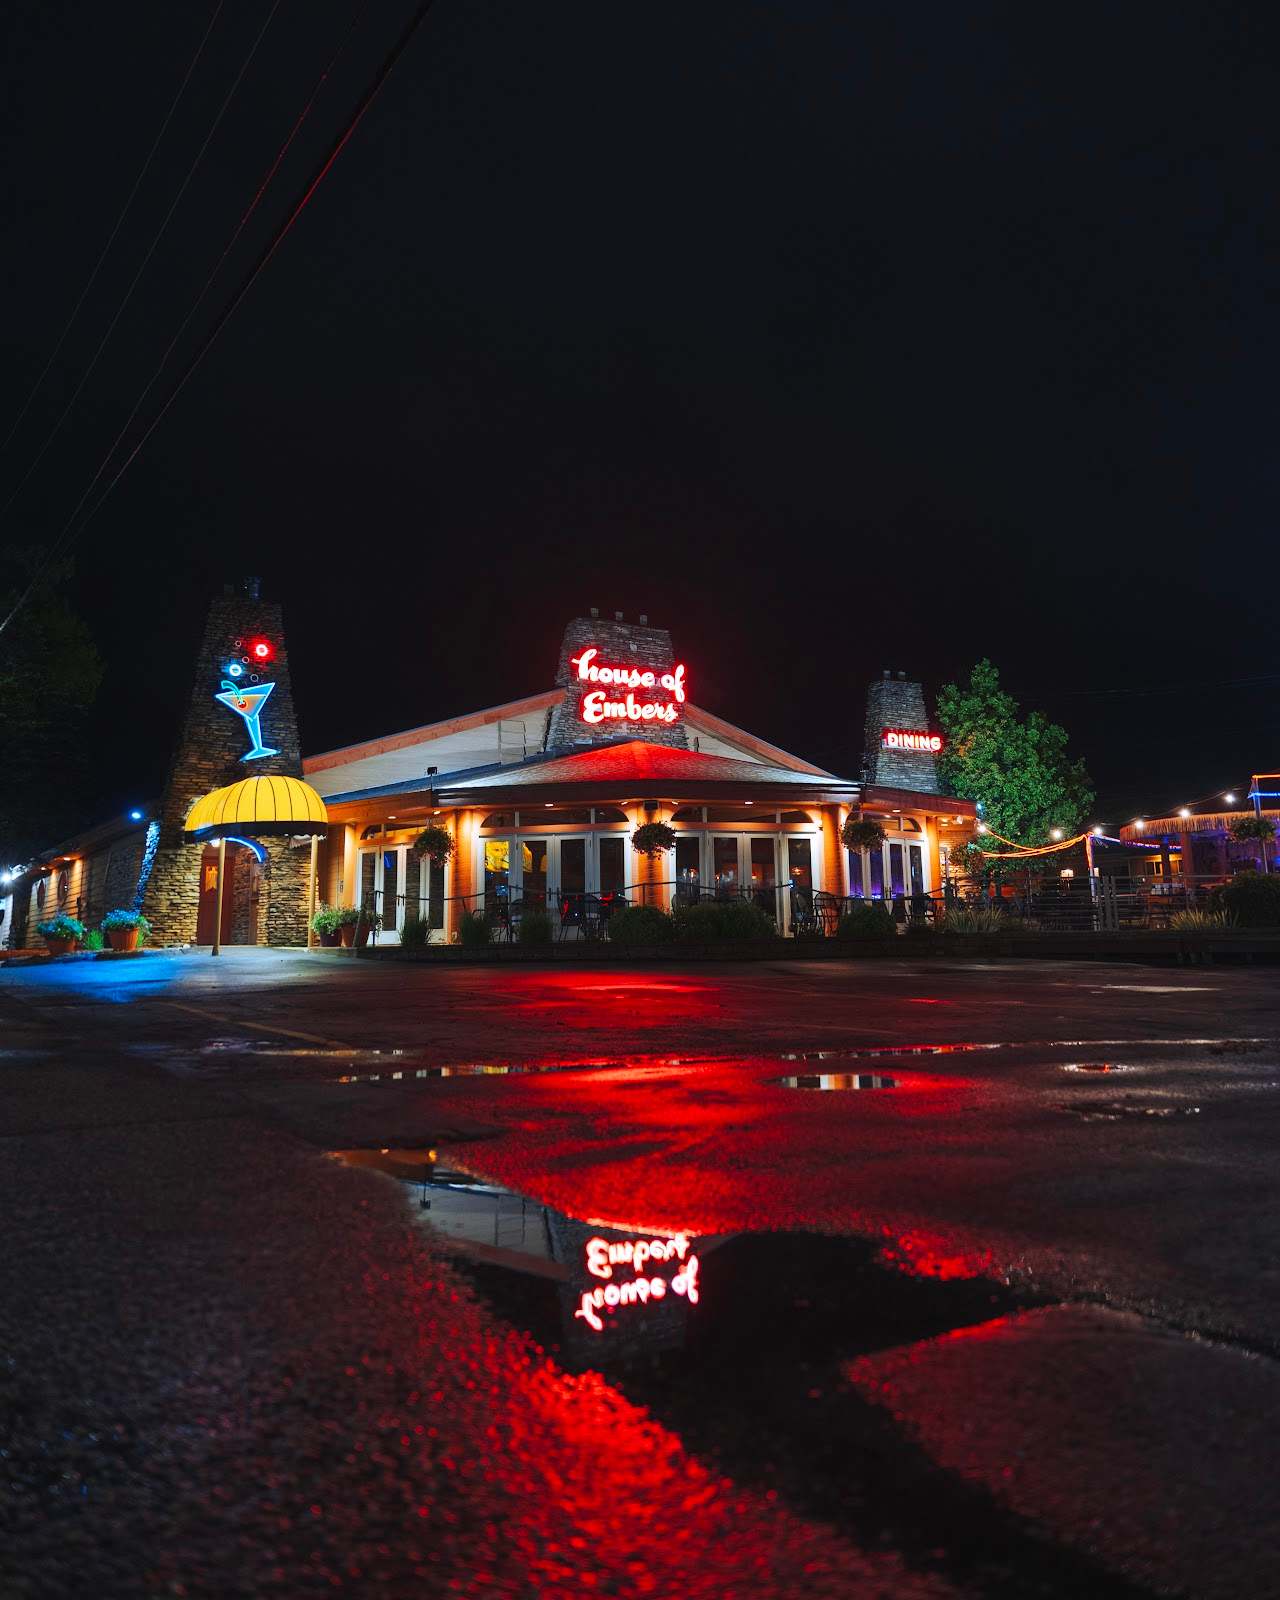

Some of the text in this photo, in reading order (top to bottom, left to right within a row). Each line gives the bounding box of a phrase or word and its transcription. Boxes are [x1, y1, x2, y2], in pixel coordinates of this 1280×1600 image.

[571, 648, 686, 703] house of
[582, 691, 679, 723] Embers
[887, 732, 942, 751] DINING
